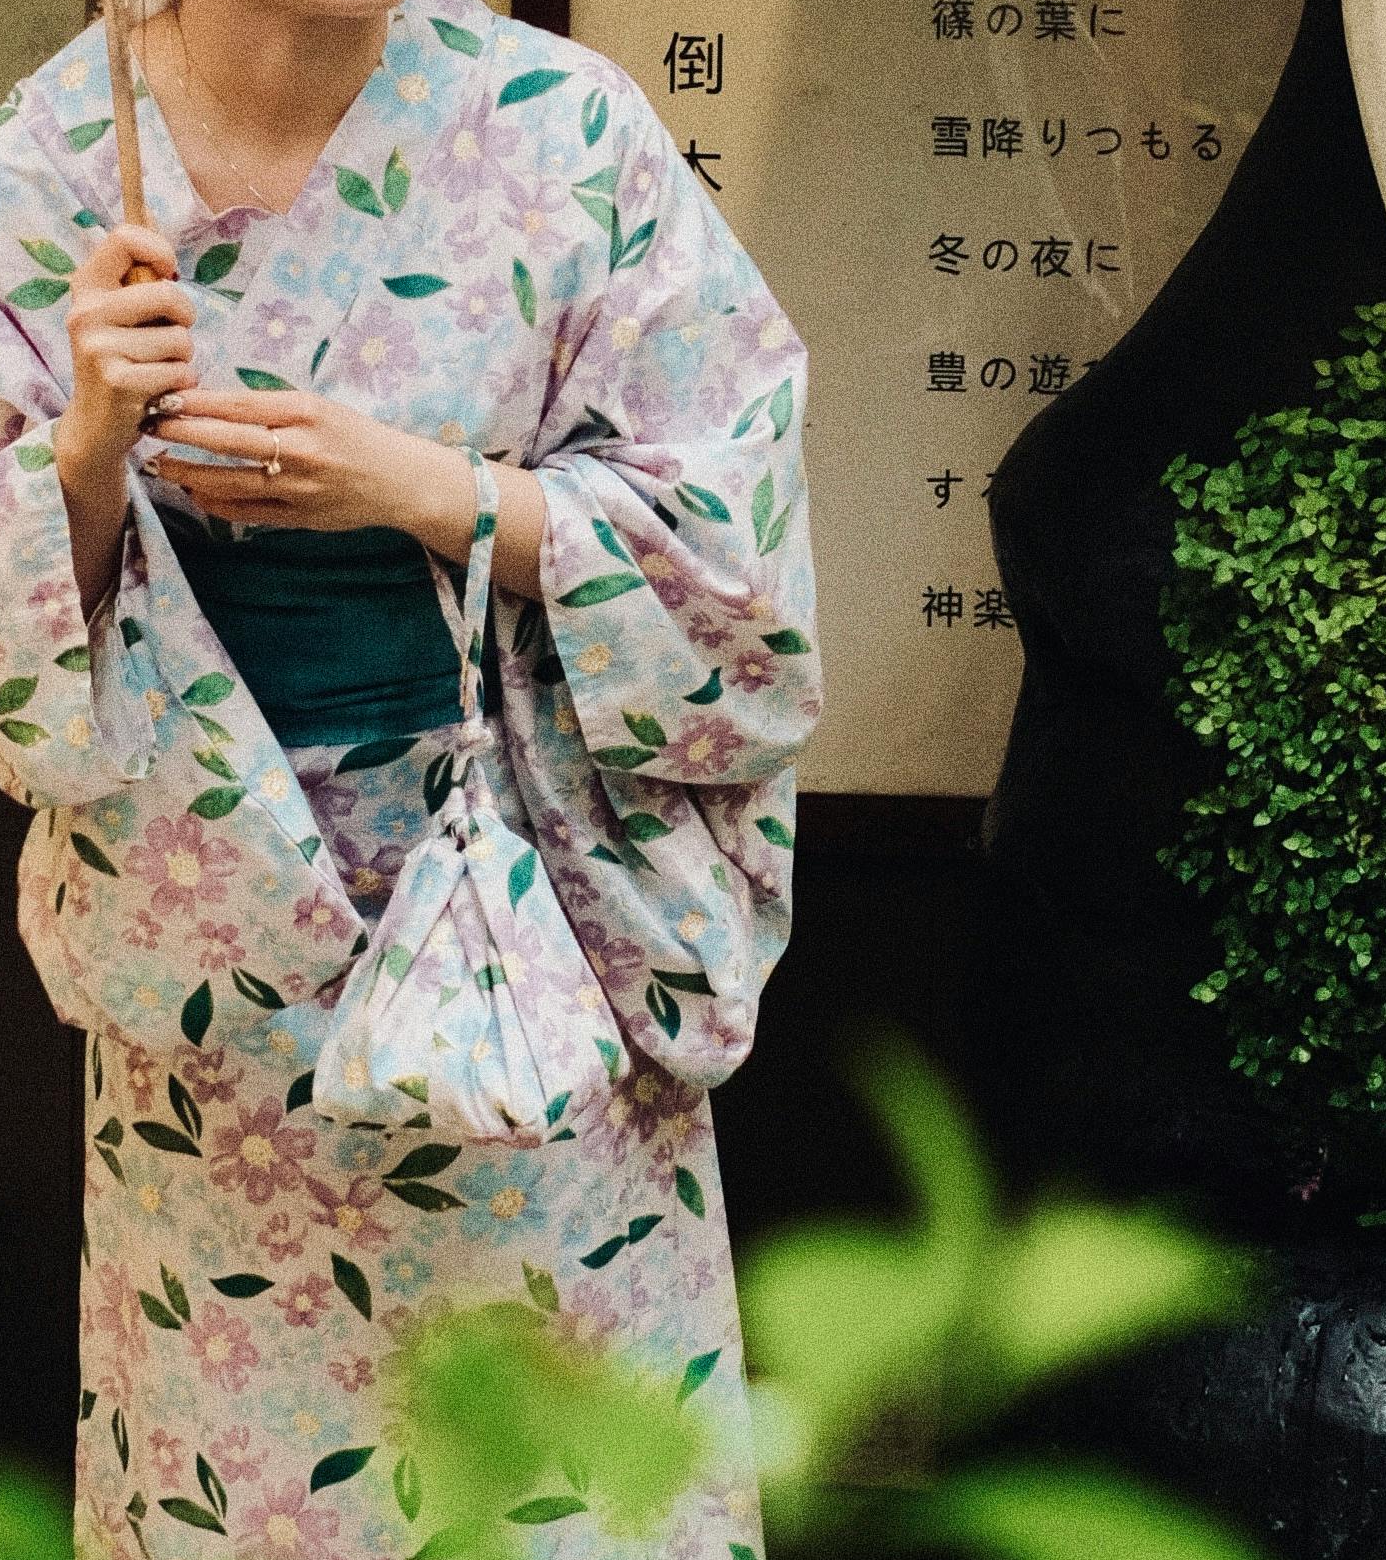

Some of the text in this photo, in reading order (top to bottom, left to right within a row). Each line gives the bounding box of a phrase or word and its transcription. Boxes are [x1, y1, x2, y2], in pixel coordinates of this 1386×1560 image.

[930, 116, 1223, 162] 雪降りつもる
[928, 233, 1121, 278] 冬の夜に
[925, 350, 1100, 394] 豊の遊
